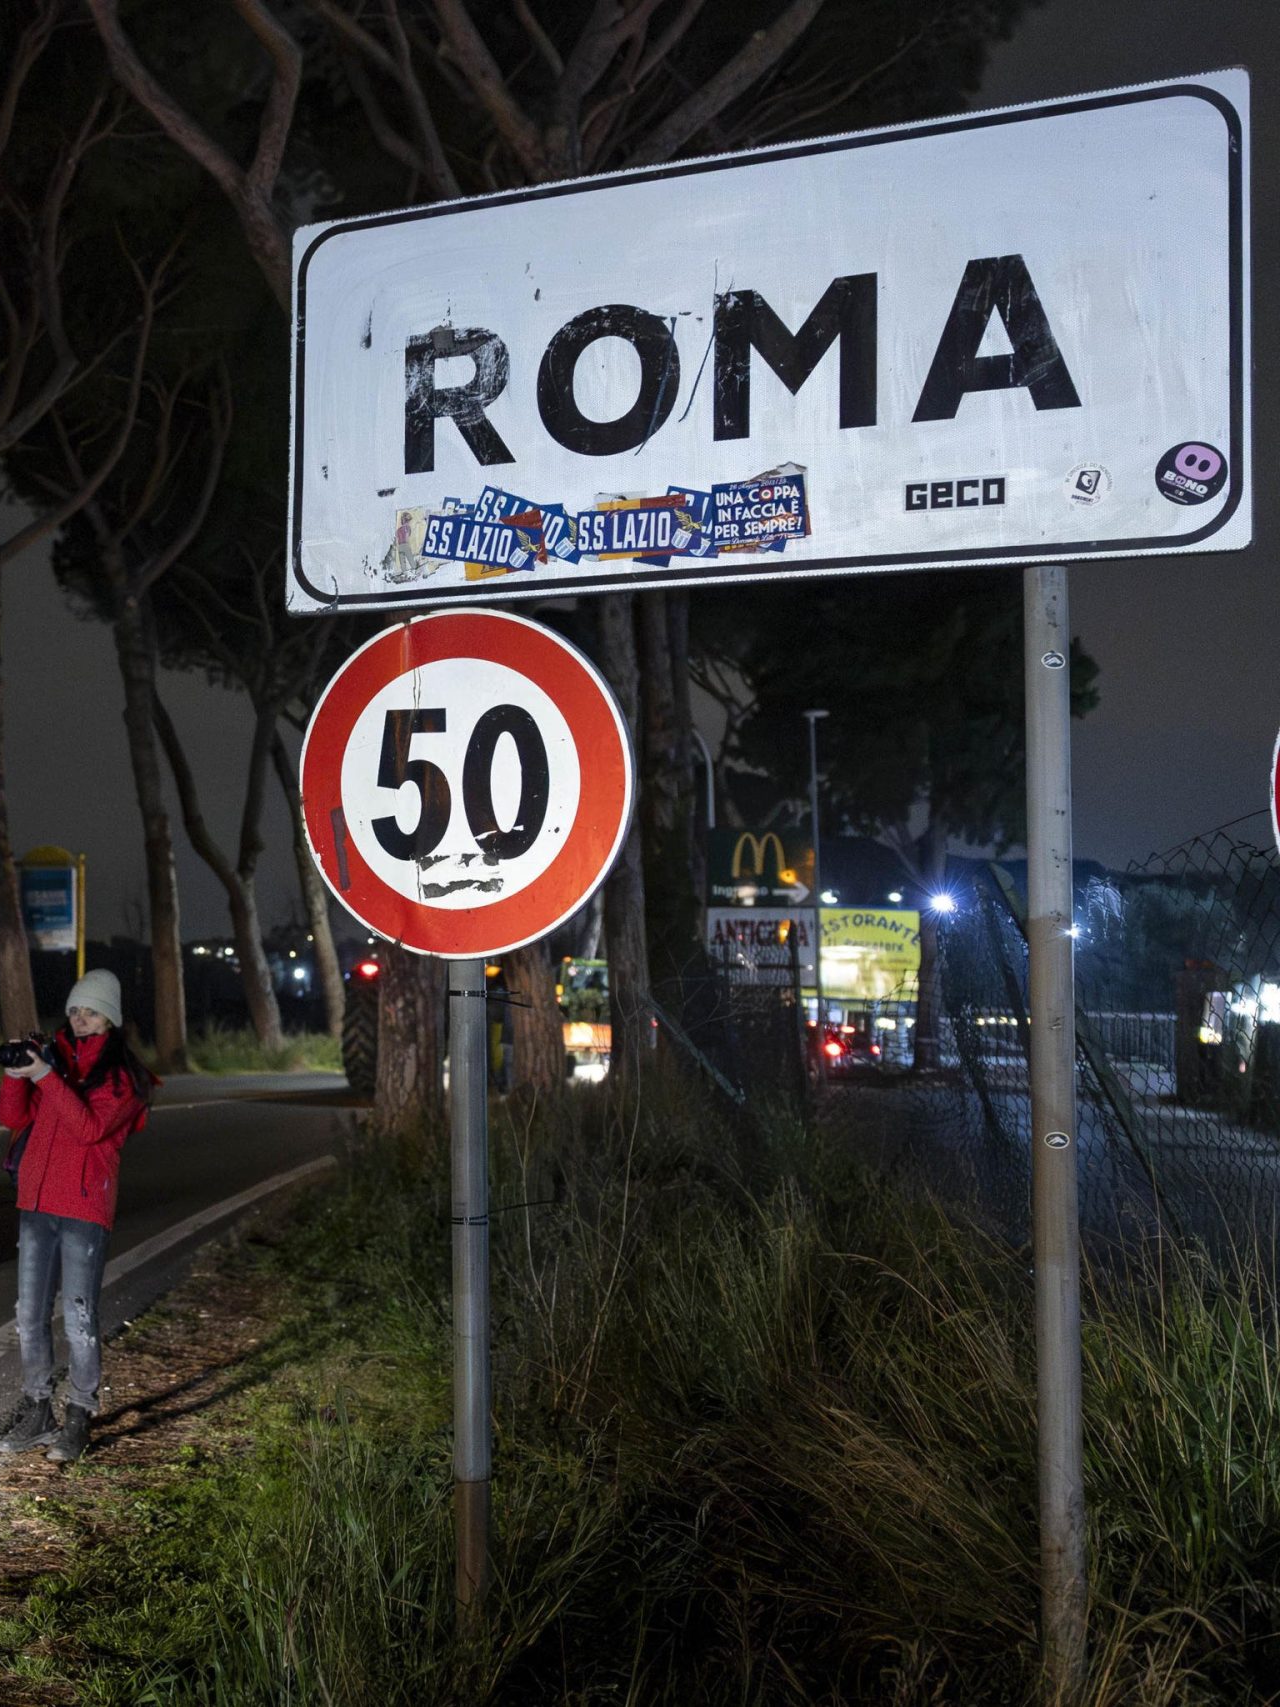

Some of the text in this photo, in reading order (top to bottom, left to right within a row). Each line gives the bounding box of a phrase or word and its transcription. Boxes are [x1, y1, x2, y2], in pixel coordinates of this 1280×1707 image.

[405, 254, 1082, 474] ROMA
[716, 485, 800, 506] UNA COPPA
[718, 499, 799, 522] IN FACCIA È
[425, 519, 453, 556] S.S.
[455, 523, 513, 563] LAZIO
[578, 515, 607, 550] S.S.
[612, 511, 671, 550] LAZIO
[715, 516, 803, 538] PER SEMPRE!
[371, 704, 549, 862] 50
[821, 914, 920, 945] ISTORANTE
